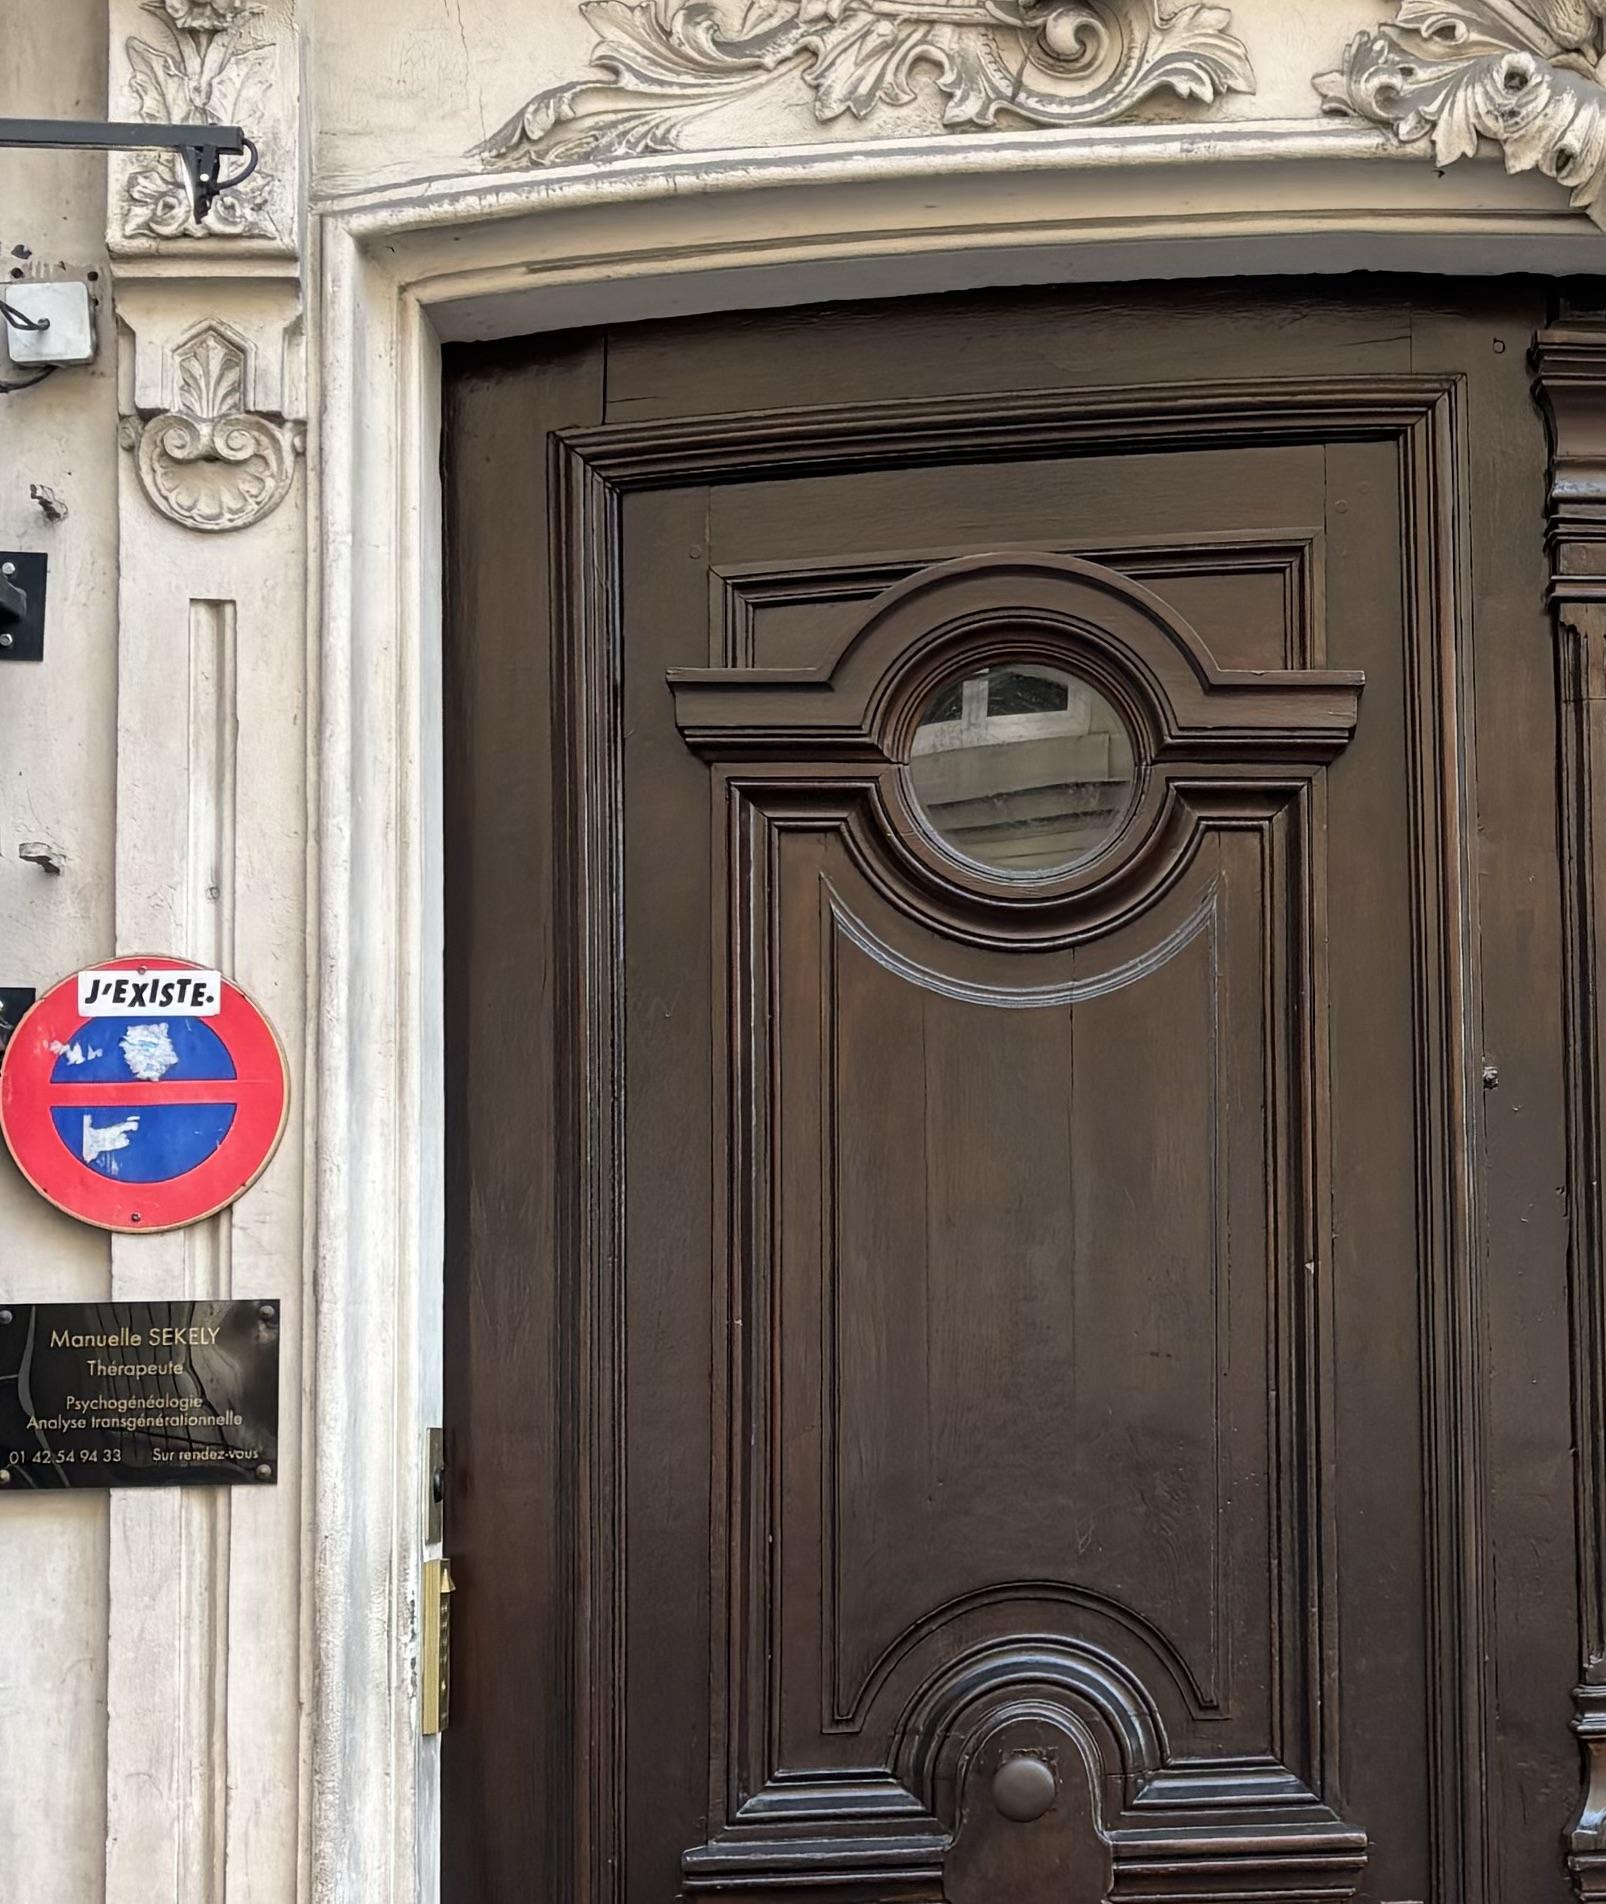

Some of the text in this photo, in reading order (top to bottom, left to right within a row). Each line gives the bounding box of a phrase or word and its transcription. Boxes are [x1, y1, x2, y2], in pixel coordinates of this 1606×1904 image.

[84, 978, 215, 1008] J'EXISTE.
[50, 1327, 221, 1348] Manuelle SEKELY
[87, 1360, 184, 1380] Thérapeute
[66, 1394, 203, 1413] Psychogénéalogie
[26, 1410, 243, 1433] Analyse transgénérationnelle
[9, 1449, 122, 1465] 01 42 54 94 33
[152, 1447, 259, 1461] Sur rendez-vous
